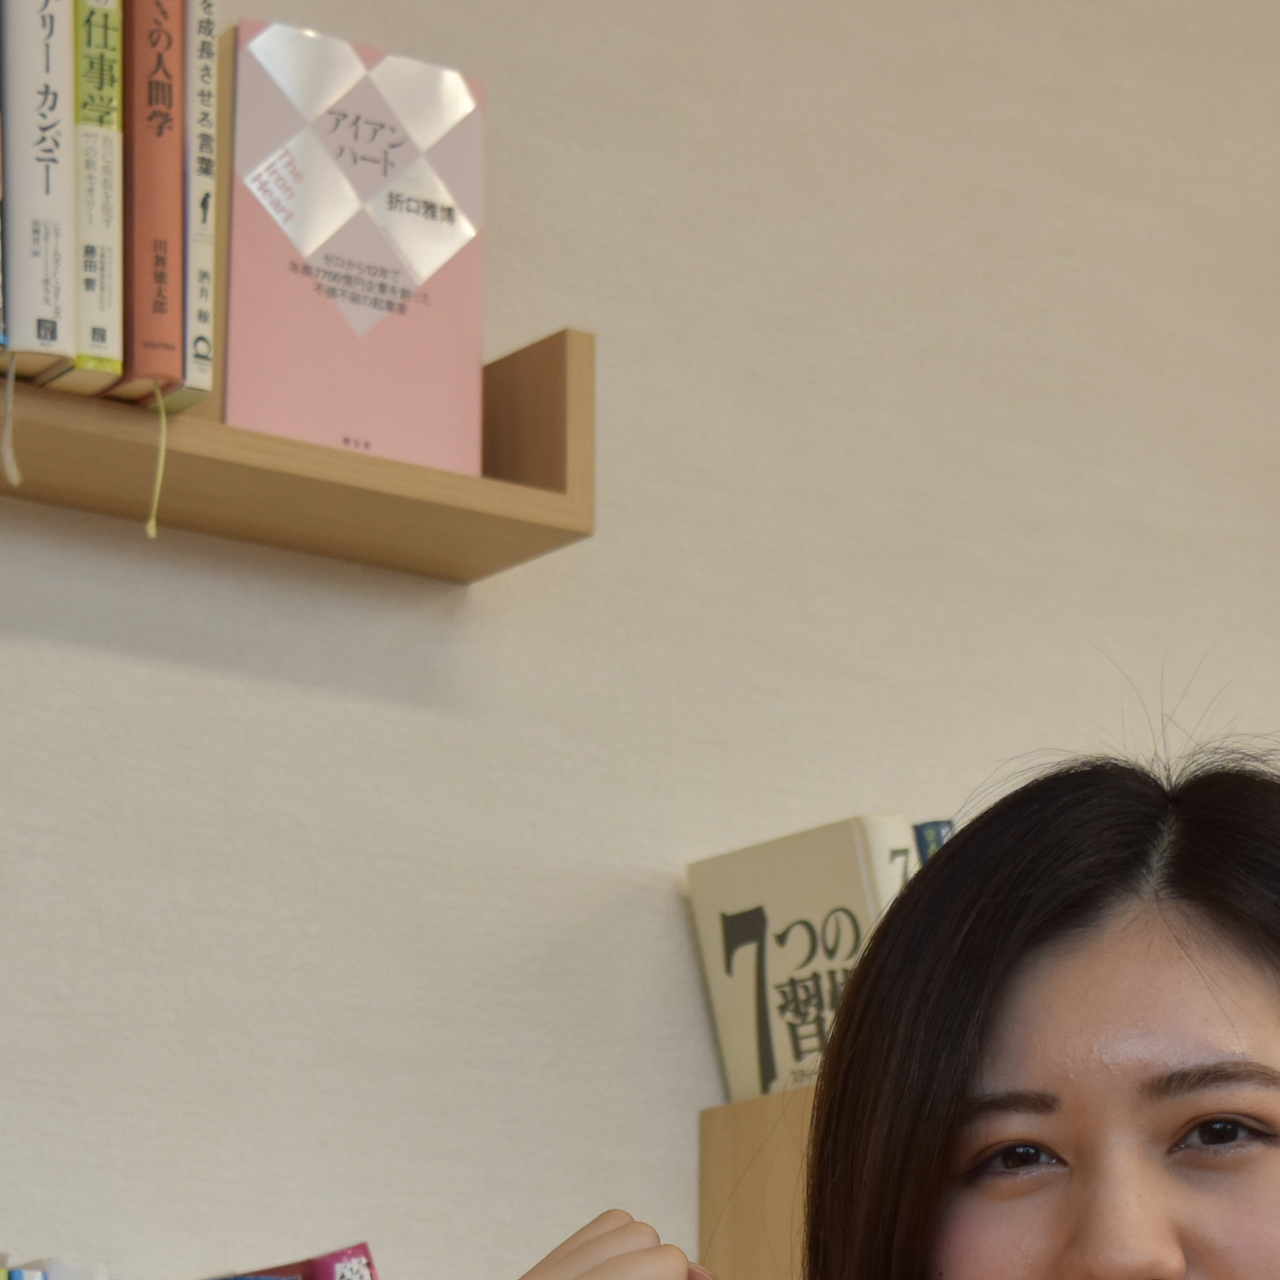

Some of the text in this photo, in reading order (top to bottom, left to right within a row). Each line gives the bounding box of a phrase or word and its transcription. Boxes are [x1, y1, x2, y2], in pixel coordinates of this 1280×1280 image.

[80, 9, 120, 127] 仕事学
[34, 83, 62, 196] カンパニー
[326, 108, 409, 150] アイアン
[263, 162, 297, 200] Iron
[275, 148, 305, 184] The
[334, 146, 397, 178] ハート
[250, 171, 297, 226] Heart
[385, 190, 457, 227] 折口雅博
[720, 905, 862, 1096] 7つの
